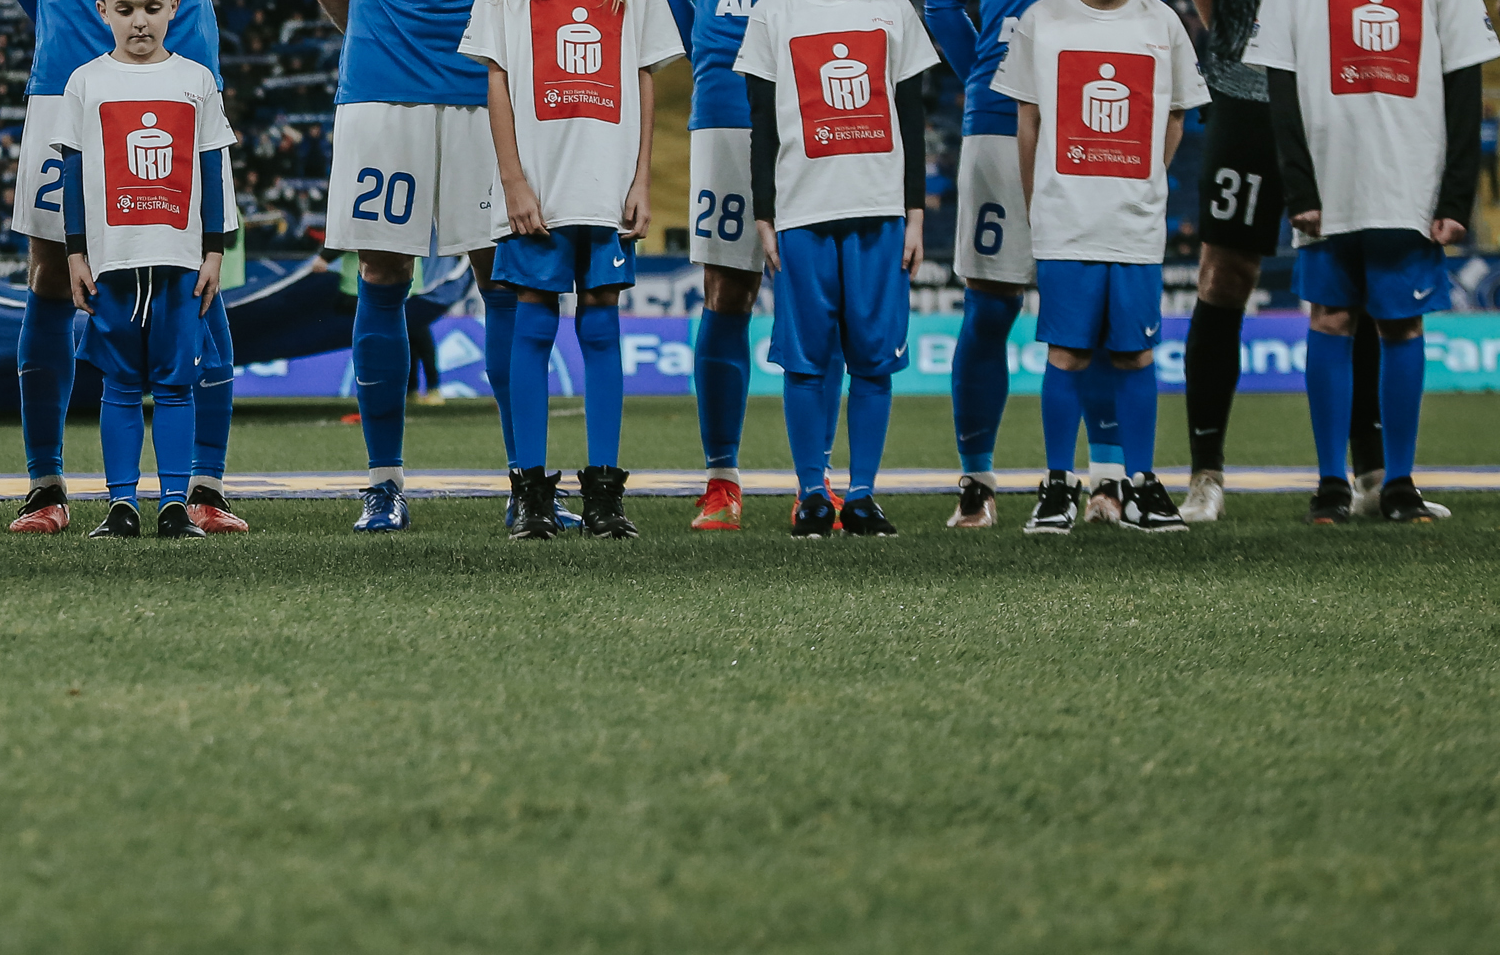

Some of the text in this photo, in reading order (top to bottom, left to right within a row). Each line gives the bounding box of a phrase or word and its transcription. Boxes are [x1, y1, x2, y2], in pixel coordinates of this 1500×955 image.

[563, 94, 614, 108] EKSTRAKLASA
[835, 130, 885, 141] EKSTRAKLASA
[352, 167, 416, 225] 20
[695, 189, 746, 242] 28
[1209, 167, 1263, 226] 31
[974, 202, 1006, 256] 6
